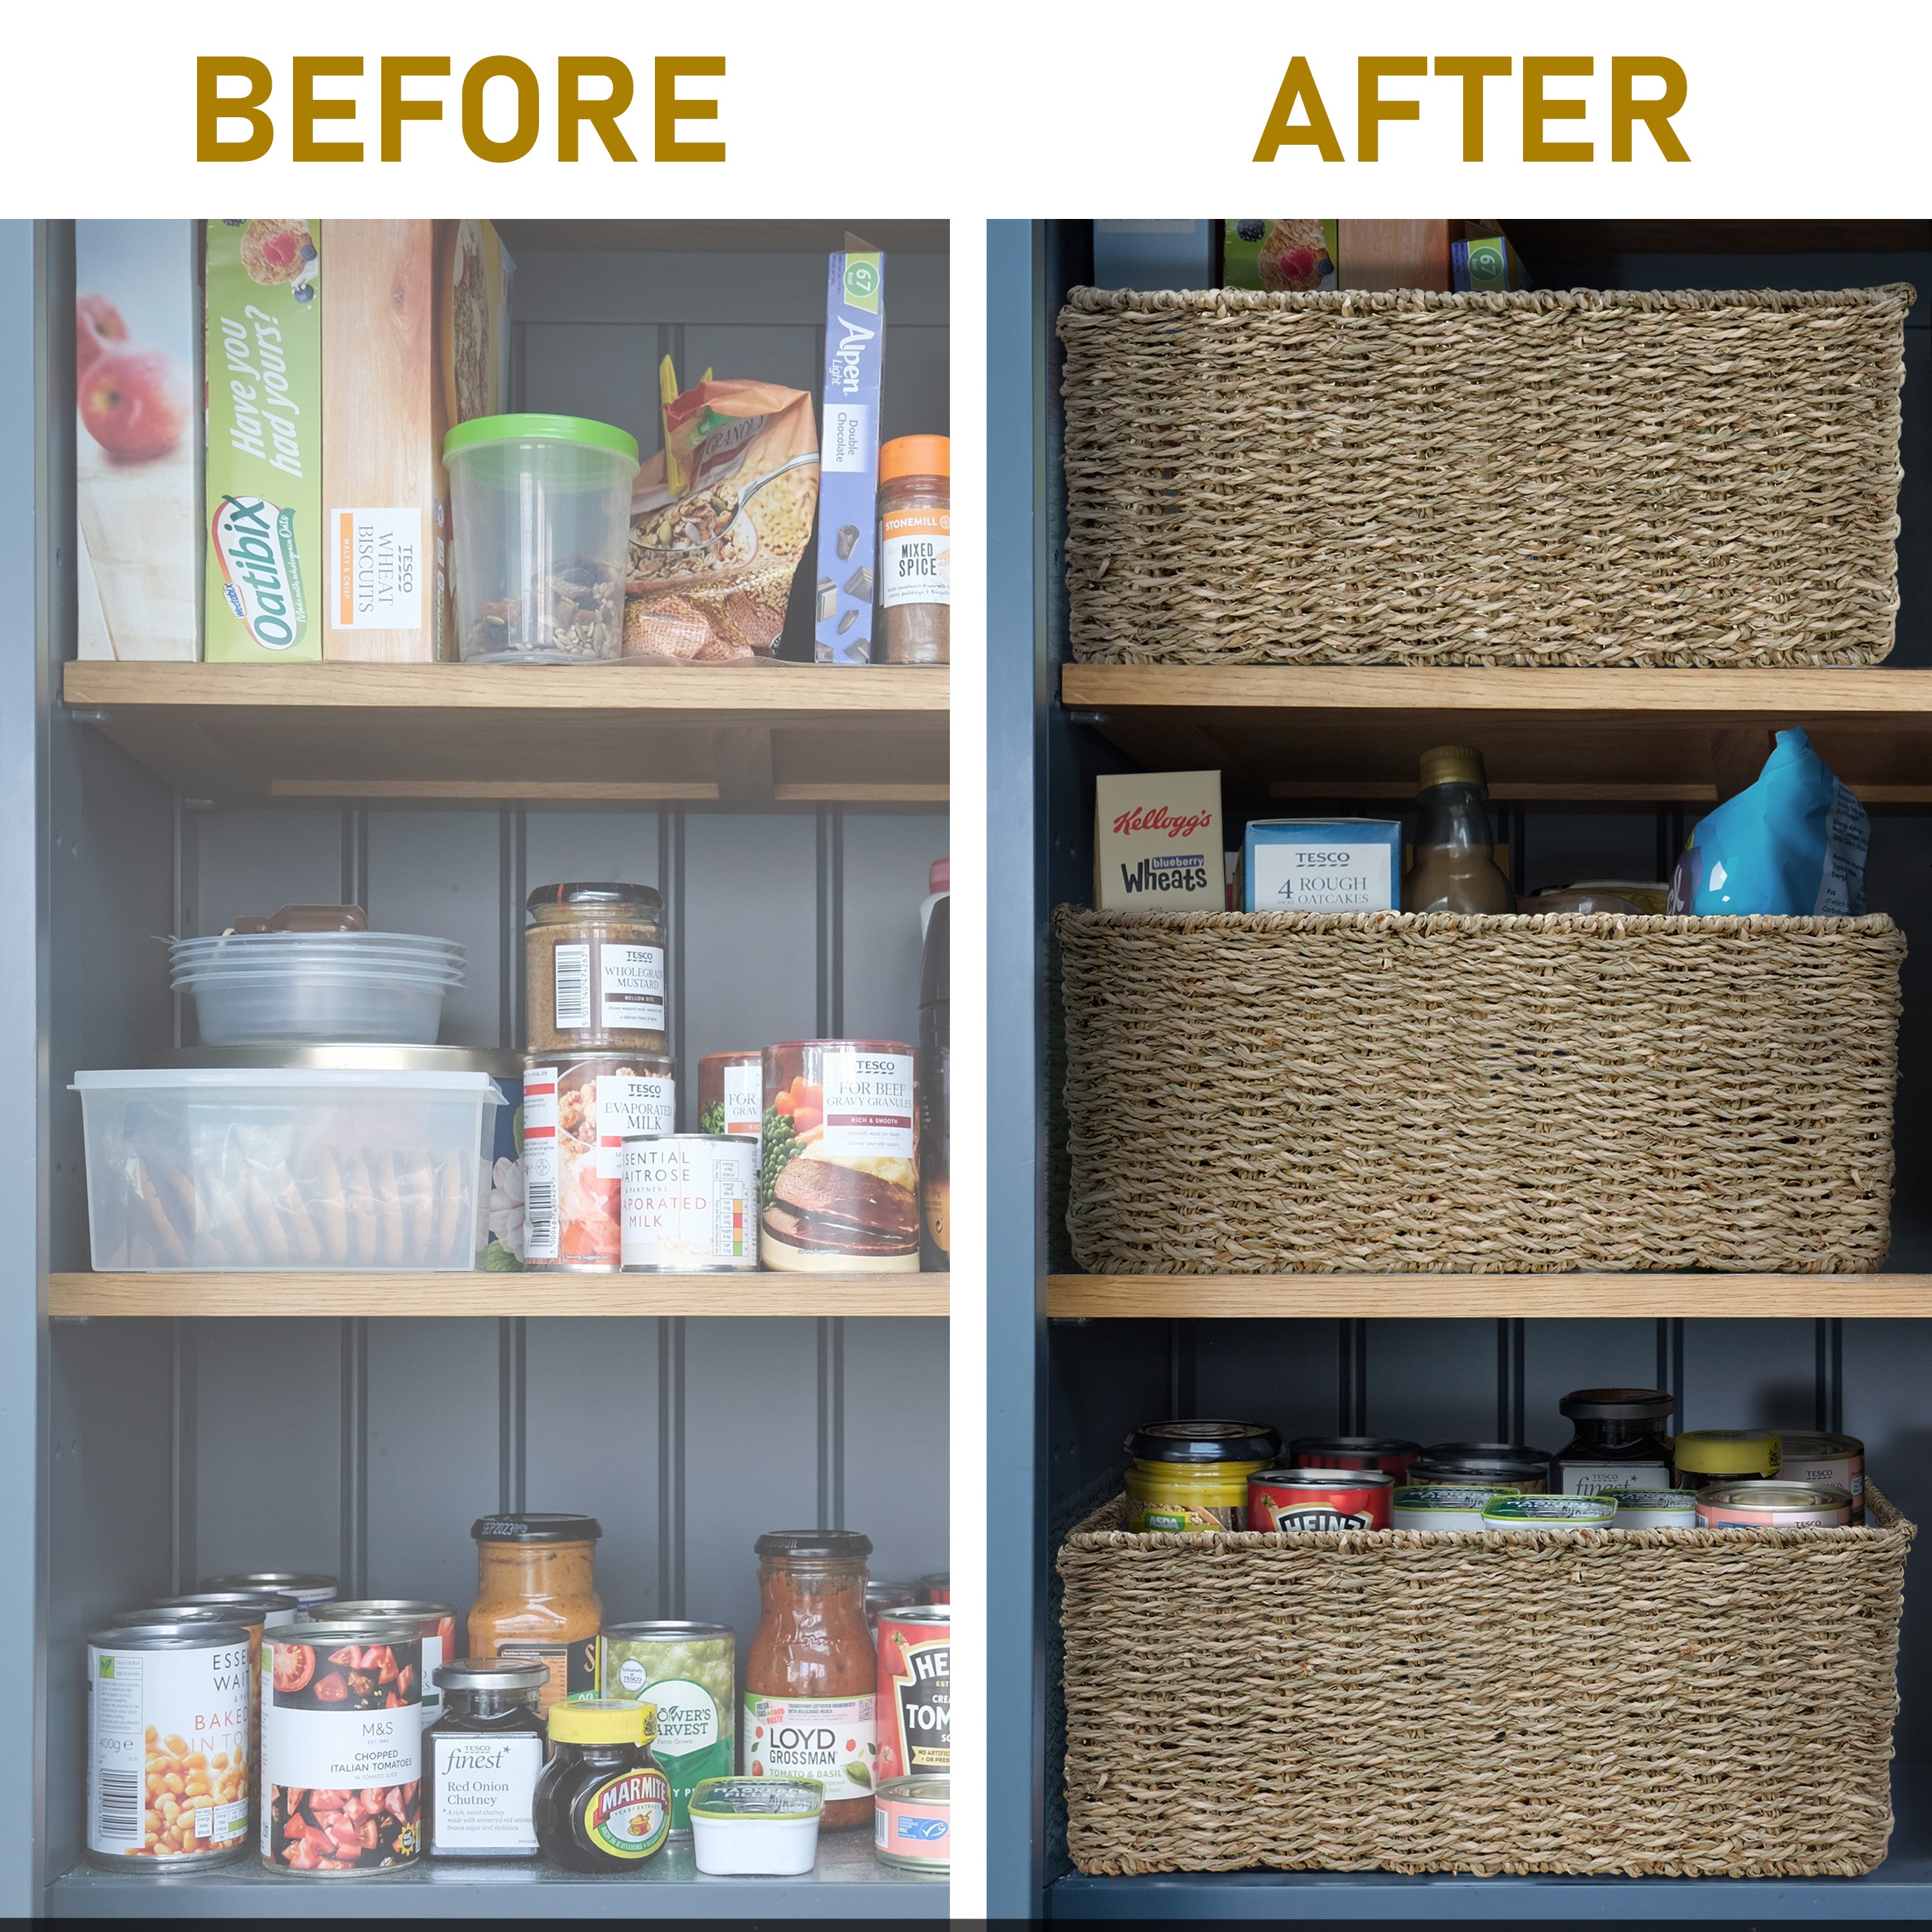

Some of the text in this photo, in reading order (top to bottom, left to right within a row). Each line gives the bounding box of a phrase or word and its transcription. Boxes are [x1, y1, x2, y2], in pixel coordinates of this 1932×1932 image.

[1479, 254, 1497, 276] 67
[856, 269, 871, 292] 67
[836, 315, 875, 393] Alpen
[829, 359, 842, 385] Light
[220, 317, 266, 459] Have you
[244, 305, 303, 478] had yours?
[837, 412, 847, 462] Chocolate
[848, 420, 858, 455] Double
[886, 517, 938, 531] STONEMILL
[902, 543, 933, 558] MIXED
[222, 495, 292, 645] Oatibix
[279, 515, 307, 622] Made with wholegrain Oats
[359, 526, 374, 612] BISCUITS
[379, 532, 393, 606] WHEAT
[403, 545, 413, 593] TESCO
[899, 558, 936, 577] SPICE
[224, 582, 244, 618] Weetabix
[1113, 806, 1212, 838] Kellogg's
[1153, 858, 1204, 867] blueberry
[1296, 852, 1350, 862] TESCO
[1121, 858, 1208, 893] Wheats
[1278, 876, 1367, 899] 4 ROUGH
[1298, 894, 1369, 904] OATCAKES
[626, 951, 653, 960] TESCO
[617, 978, 659, 990] MUSTARD
[858, 1061, 895, 1071] TESCO
[628, 1084, 661, 1094] TESCO
[839, 1081, 906, 1097] FOR BEEF
[729, 1094, 756, 1105] FOR
[827, 1097, 912, 1109] GRAVY GRANULES
[605, 1103, 672, 1117] EVAPORATED
[627, 1115, 661, 1130] MILK
[629, 1215, 662, 1227] MILK
[1149, 1515, 1179, 1530] ASDA
[363, 1721, 393, 1736] M&S
[99, 1738, 120, 1753] 400g
[191, 1736, 214, 1753] IN
[770, 1727, 835, 1749] LOYD
[355, 1750, 398, 1761] CHOPPED
[442, 1748, 504, 1775] finest
[770, 1750, 835, 1765] GROSSMAN
[330, 1757, 412, 1772] ITALIAN TOMATOES
[770, 1768, 804, 1777] TOMATO
[448, 1781, 509, 1792] Red Onion
[448, 1794, 497, 1807] Chutney
[602, 1776, 666, 1813] MARMITE
[615, 1807, 634, 1815] YEAST
